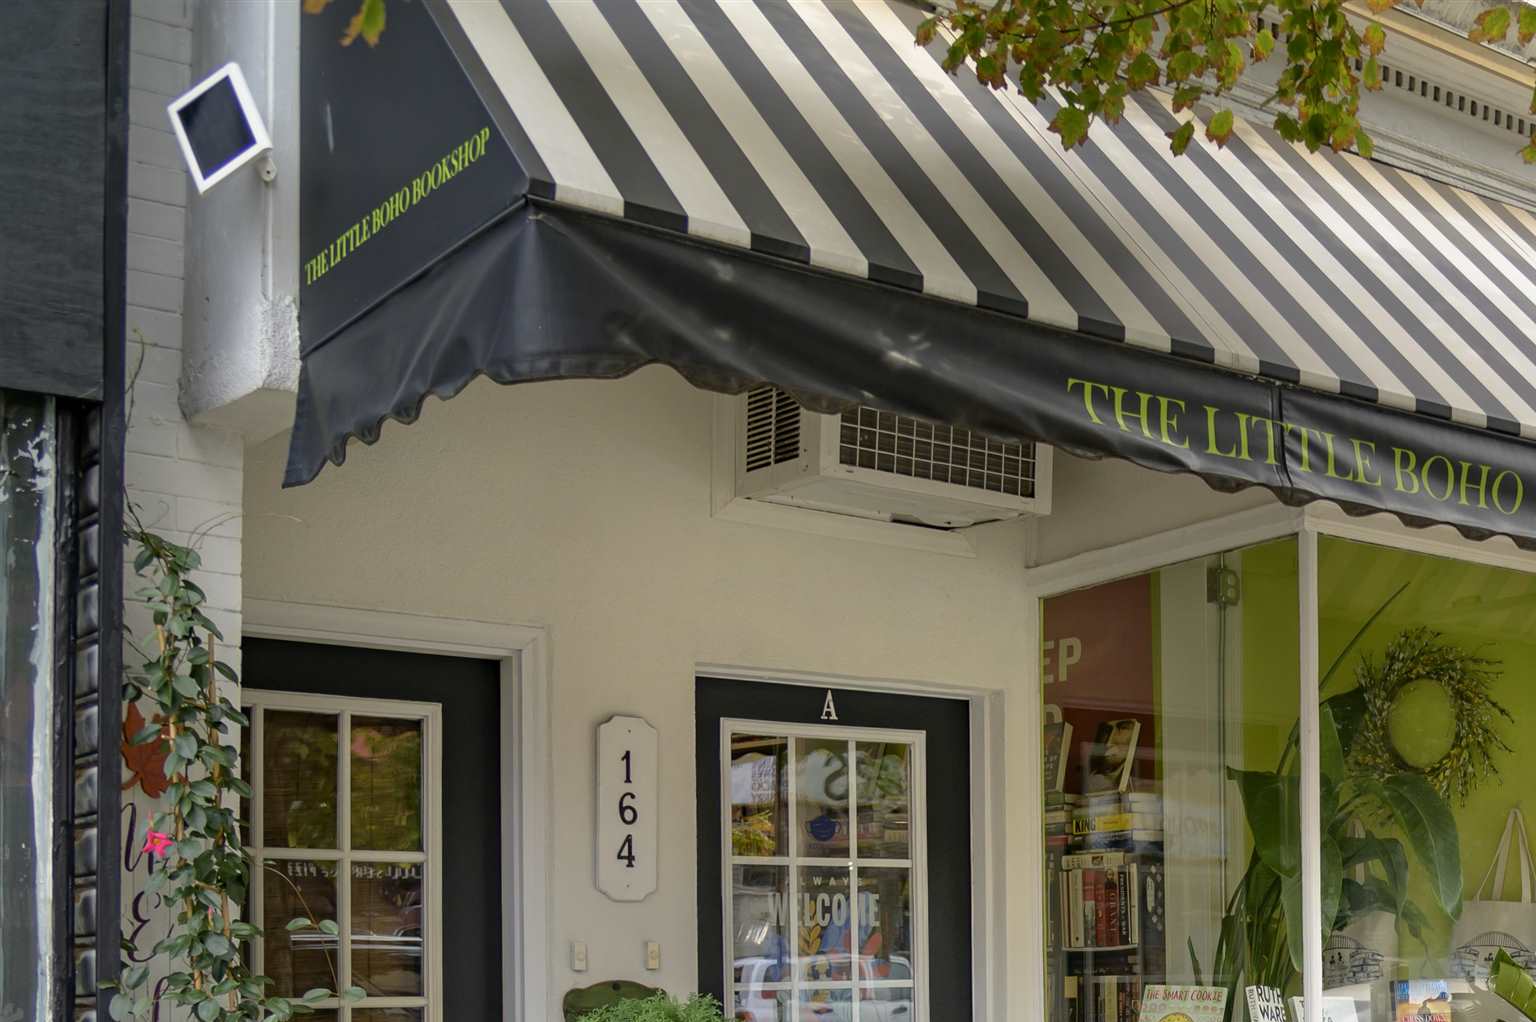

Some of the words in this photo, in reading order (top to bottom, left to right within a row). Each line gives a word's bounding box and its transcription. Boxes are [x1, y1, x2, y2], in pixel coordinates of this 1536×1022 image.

[304, 248, 329, 285] THE
[329, 215, 371, 268] LITTLE
[371, 187, 410, 234] BOHO
[411, 126, 490, 206] BOOKSHOP
[1067, 377, 1190, 450] THE
[1203, 404, 1384, 488] LITTLE
[1392, 447, 1524, 517] BOHO
[820, 688, 839, 720] A
[617, 749, 640, 869] 164
[1163, 990, 1189, 1000] SMART
[1190, 990, 1223, 1001] COOKIE
[1258, 1005, 1287, 1022] WARE
